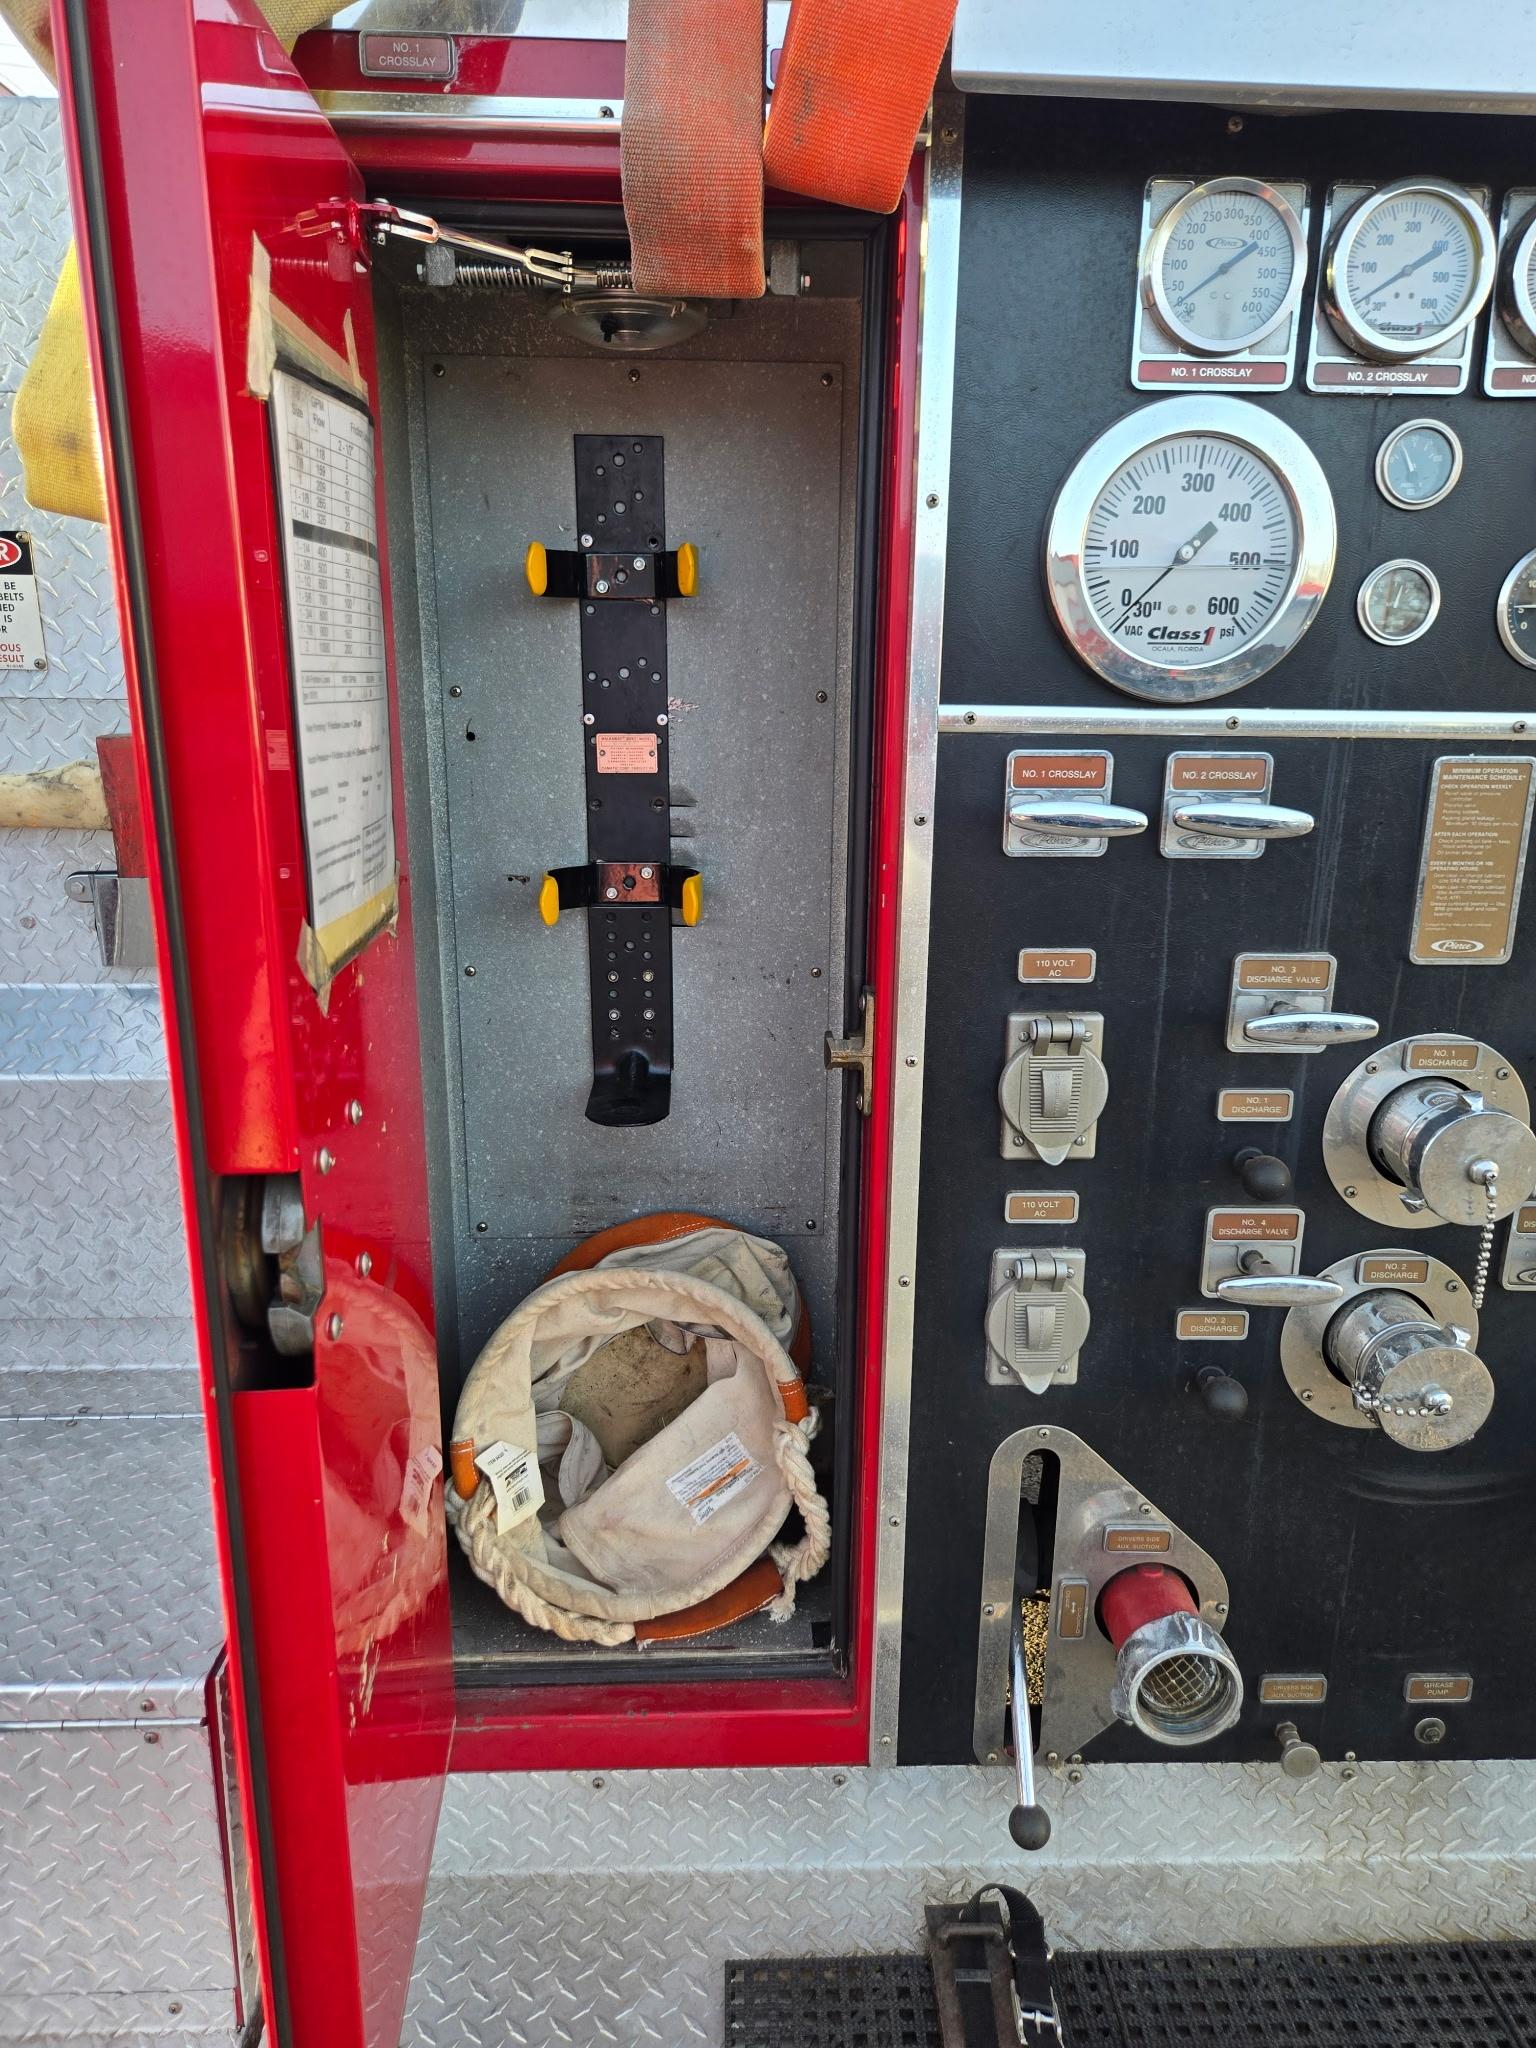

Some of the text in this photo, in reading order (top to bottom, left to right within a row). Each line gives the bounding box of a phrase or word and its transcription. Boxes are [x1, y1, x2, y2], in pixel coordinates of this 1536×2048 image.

[393, 42, 419, 53] NO. 1
[379, 56, 436, 66] CROSSLAY
[1203, 211, 1221, 222] 250
[1224, 208, 1244, 219] 300
[1244, 215, 1261, 226] 350
[1186, 223, 1206, 234] 200
[1404, 222, 1421, 232] 300
[1249, 230, 1269, 240] 400
[1177, 240, 1193, 250] 150
[1376, 235, 1394, 246] 200
[1257, 247, 1276, 257] 450
[1171, 260, 1187, 270] 100
[1361, 262, 1377, 273] 100
[1257, 269, 1277, 279] 500
[1432, 272, 1449, 283] 500
[1172, 281, 1184, 291] 50
[1252, 288, 1270, 298] 550
[1183, 303, 1195, 313] 30
[1242, 302, 1262, 312] 600
[1421, 298, 1437, 309] 600
[1171, 368, 1253, 377] NO. 1 CROSSLAY
[1347, 372, 1428, 382] NO. 2 CROSSLAY
[1181, 473, 1215, 492] 300
[1132, 496, 1166, 515] 200
[1218, 503, 1252, 522] 400
[1110, 540, 1139, 558] 100
[1229, 552, 1261, 570] 500
[4, 582, 16, 590] BE
[1121, 589, 1132, 607] 0
[1133, 601, 1161, 618] 30"
[1208, 597, 1239, 615] 600
[4, 615, 12, 623] IS
[1125, 625, 1142, 636] VAC
[1520, 622, 1527, 630] 0
[1220, 626, 1235, 639] psi
[1022, 770, 1097, 779] NO. 1 CROSSLAY
[1208, 772, 1258, 780] CROSSLAY
[1443, 941, 1472, 950] Pierce
[1048, 969, 1062, 977] AC
[1296, 976, 1321, 984] VALVE
